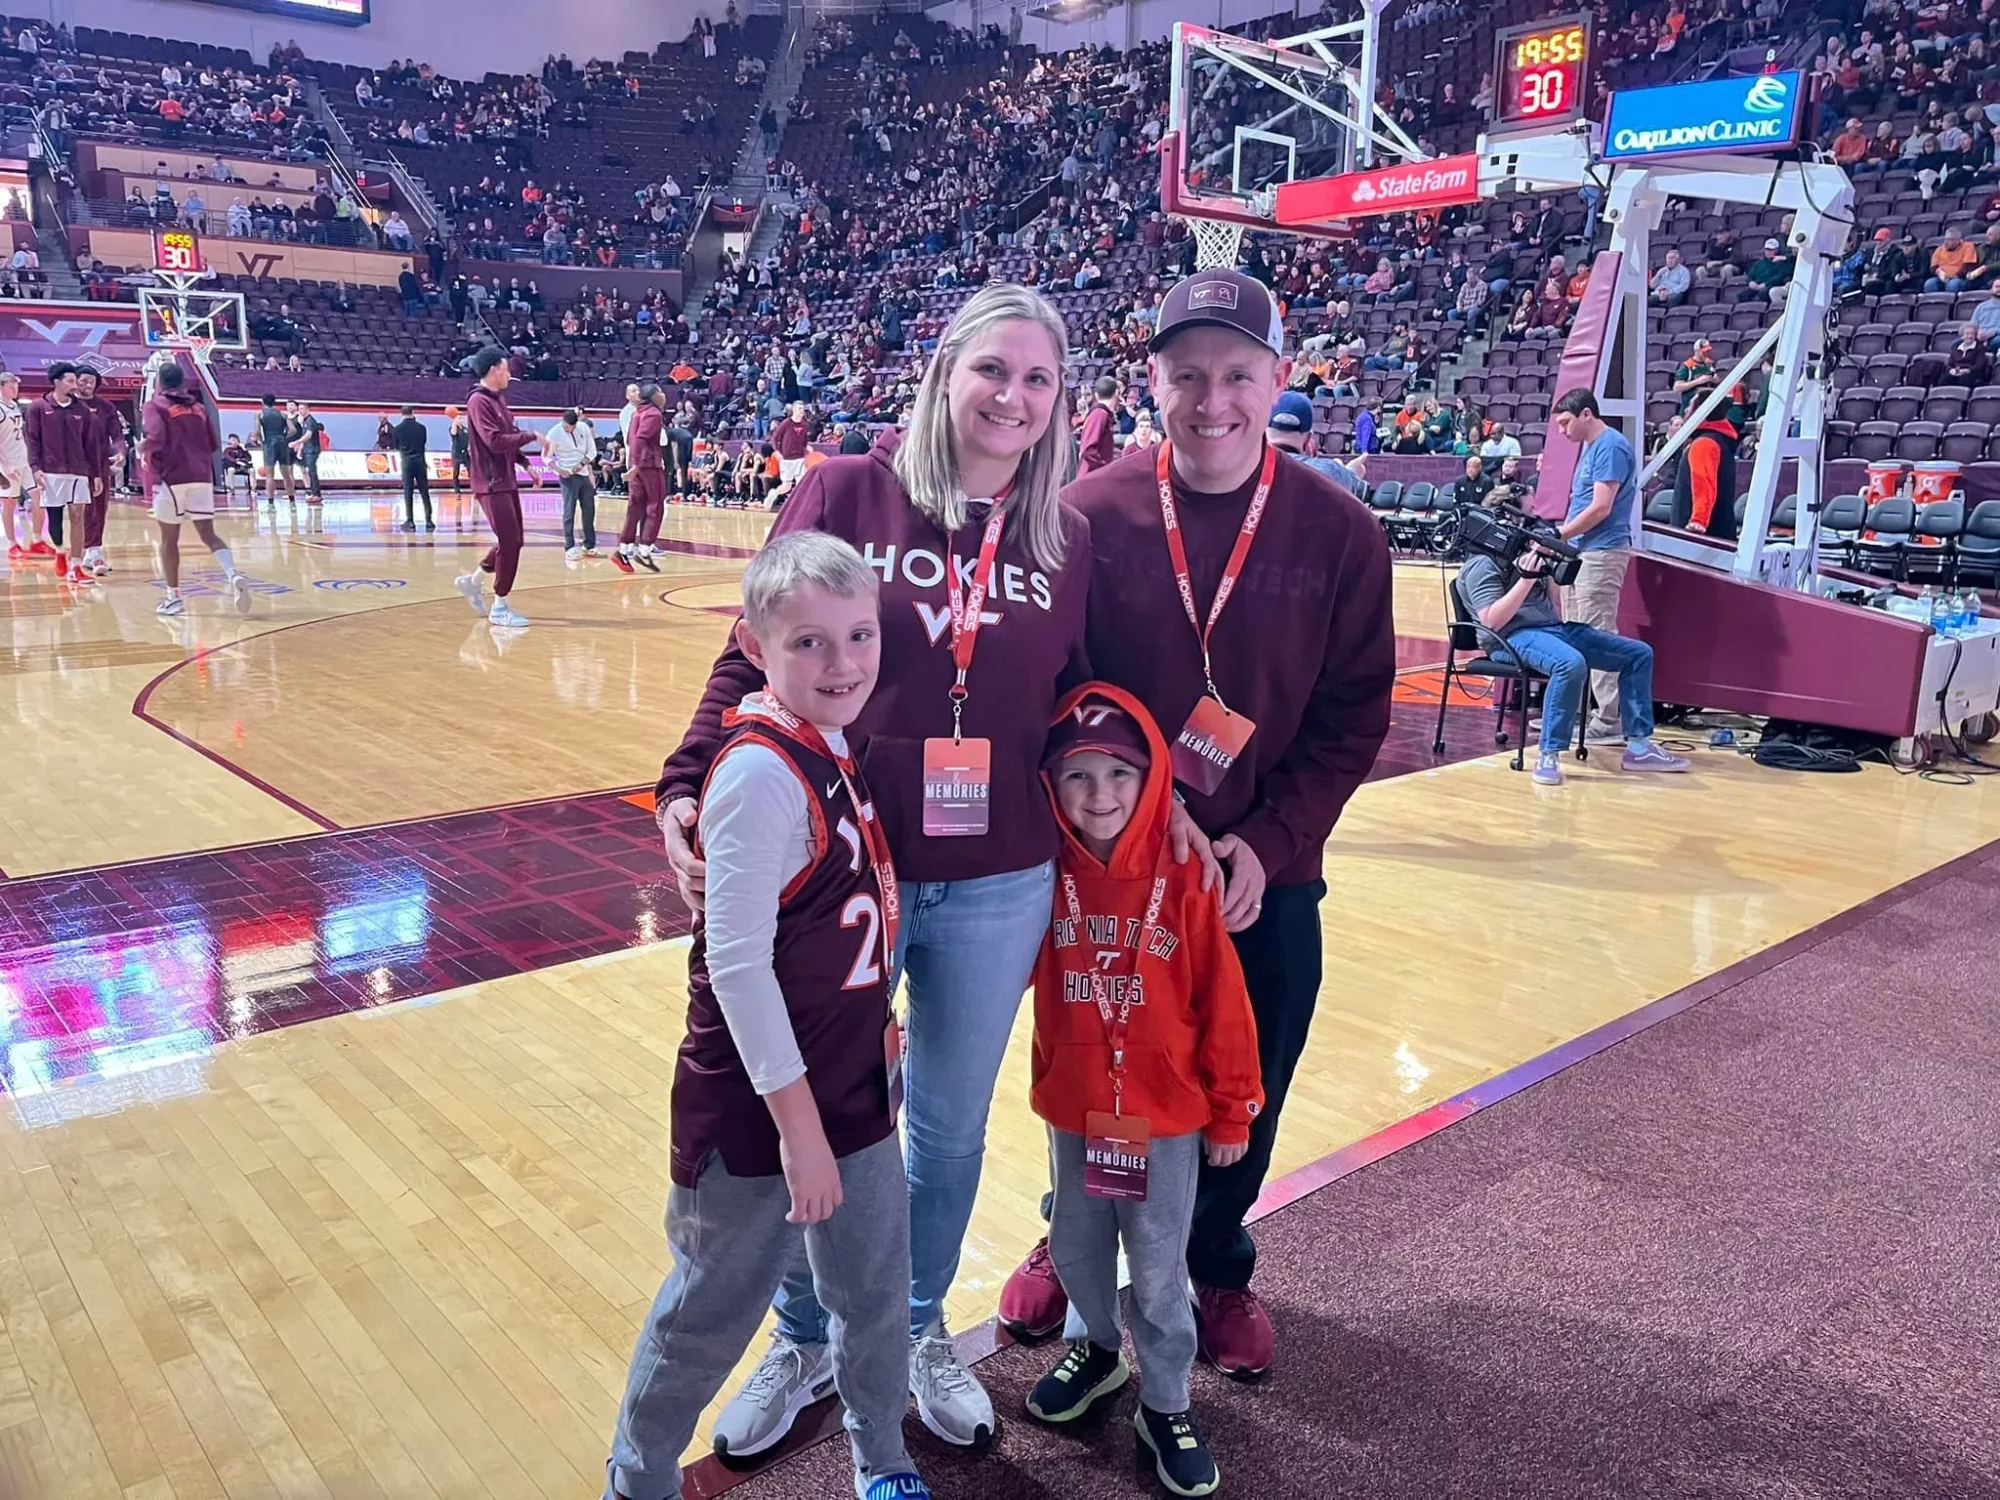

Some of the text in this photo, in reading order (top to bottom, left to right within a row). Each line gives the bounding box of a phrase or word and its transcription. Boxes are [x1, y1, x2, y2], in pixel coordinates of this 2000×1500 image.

[1516, 31, 1583, 68] 19:55
[1522, 70, 1563, 113] 30
[163, 233, 194, 248] 19:55
[164, 247, 190, 268] 30
[237, 252, 284, 278] VT
[20, 319, 133, 347] VT
[1159, 479, 1177, 531] HOKIES
[1241, 483, 1269, 536] HOKIES
[864, 542, 1052, 611] HOKIES
[964, 583, 985, 632] HOKIES
[1177, 573, 1196, 624] HOKIES
[1207, 576, 1234, 625] HOKIES
[1073, 704, 1125, 727] VT
[1178, 730, 1234, 769] MEMORIES
[925, 783, 987, 799] MEMORIES
[880, 862, 899, 920] HOKIES
[1063, 874, 1082, 924] HOKIES
[1144, 877, 1166, 930] HOKIES
[1064, 970, 1145, 1005] HOIES
[1089, 967, 1113, 1020] HOKIES
[1086, 1149, 1146, 1171] MEMORIES
